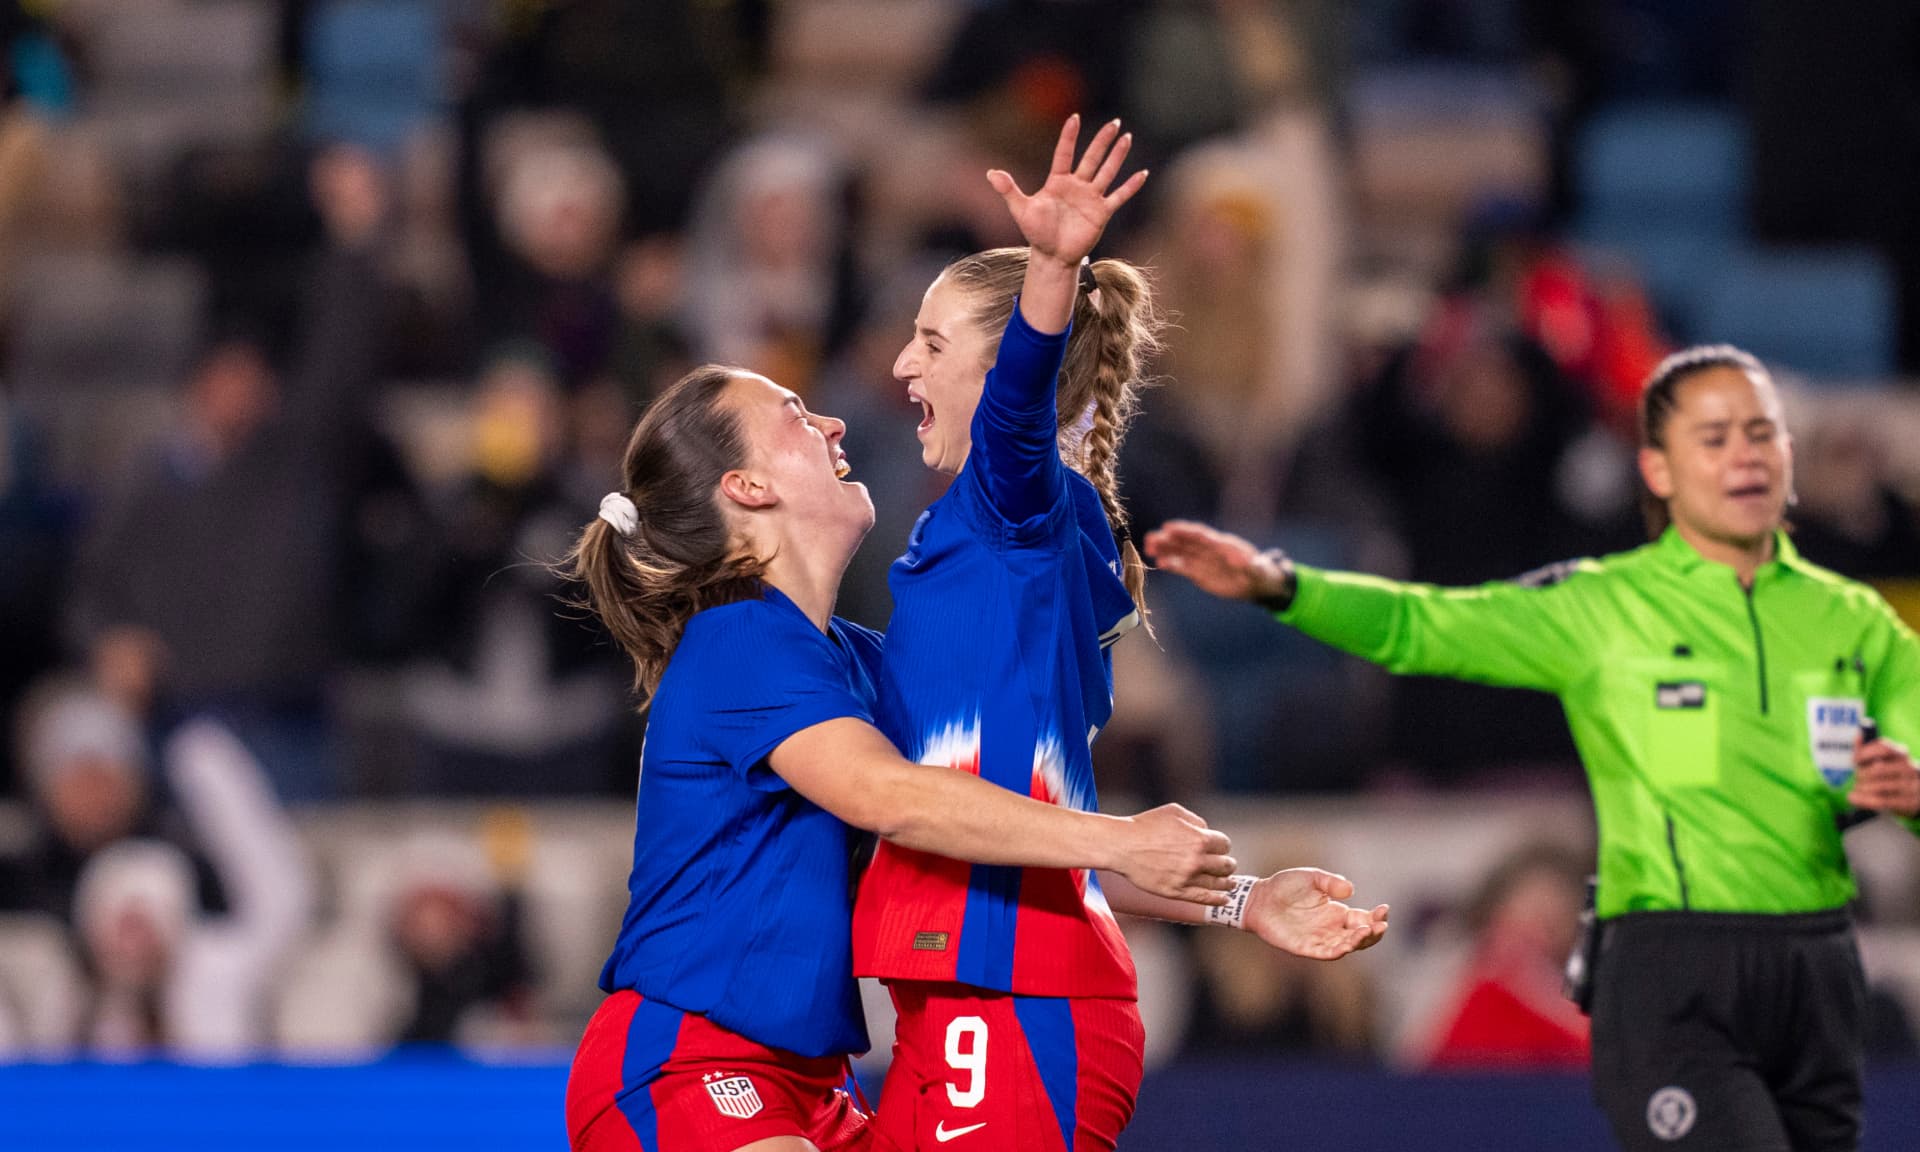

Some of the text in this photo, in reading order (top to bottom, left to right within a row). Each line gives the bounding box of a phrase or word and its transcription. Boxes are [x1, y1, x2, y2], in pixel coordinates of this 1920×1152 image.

[1816, 706, 1858, 726] FIFA
[945, 1016, 988, 1108] 9
[710, 1079, 751, 1096] USA
